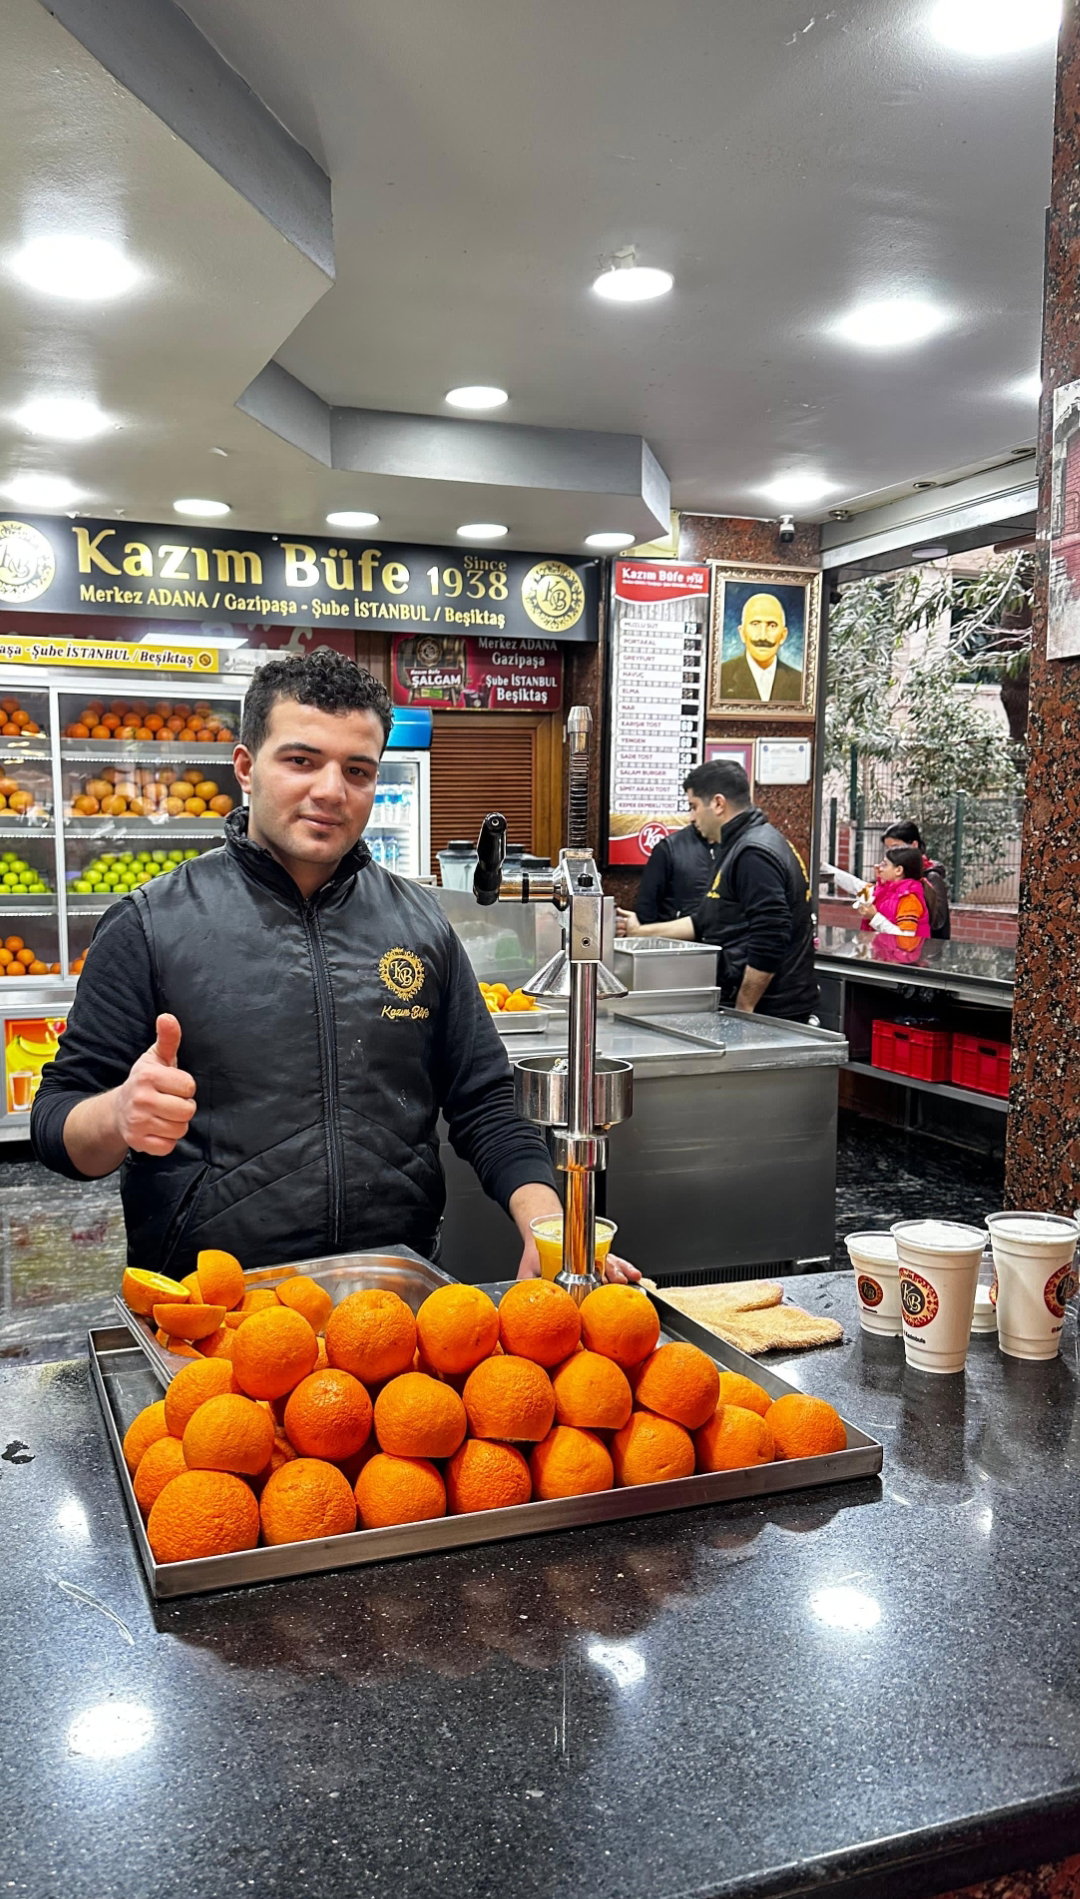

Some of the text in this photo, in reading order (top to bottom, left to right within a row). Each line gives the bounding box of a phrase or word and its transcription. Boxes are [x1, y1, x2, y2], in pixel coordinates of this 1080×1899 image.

[72, 527, 509, 601] Kazım Büfe 1938
[463, 555, 507, 571] Since
[622, 567, 657, 581] Kazım
[658, 570, 684, 583] Büfe
[80, 584, 144, 604] Merkez
[147, 588, 209, 608] ADANA
[224, 593, 298, 616] Gazipaşa
[312, 598, 350, 619] Şube
[354, 597, 431, 621] İSTANBUL
[444, 606, 506, 629] Beşiktaş
[478, 637, 558, 651] Merkez ADANA
[32, 645, 64, 659] Şube
[66, 643, 129, 660] İSTANBUL
[140, 651, 193, 668] Beşiktaş
[492, 652, 546, 669] Gazipaşa
[411, 674, 461, 688] ŞALGAM
[485, 673, 558, 688] Şube İSTANBUL
[496, 687, 548, 704] Beşiktaş
[680, 752, 692, 764] 50
